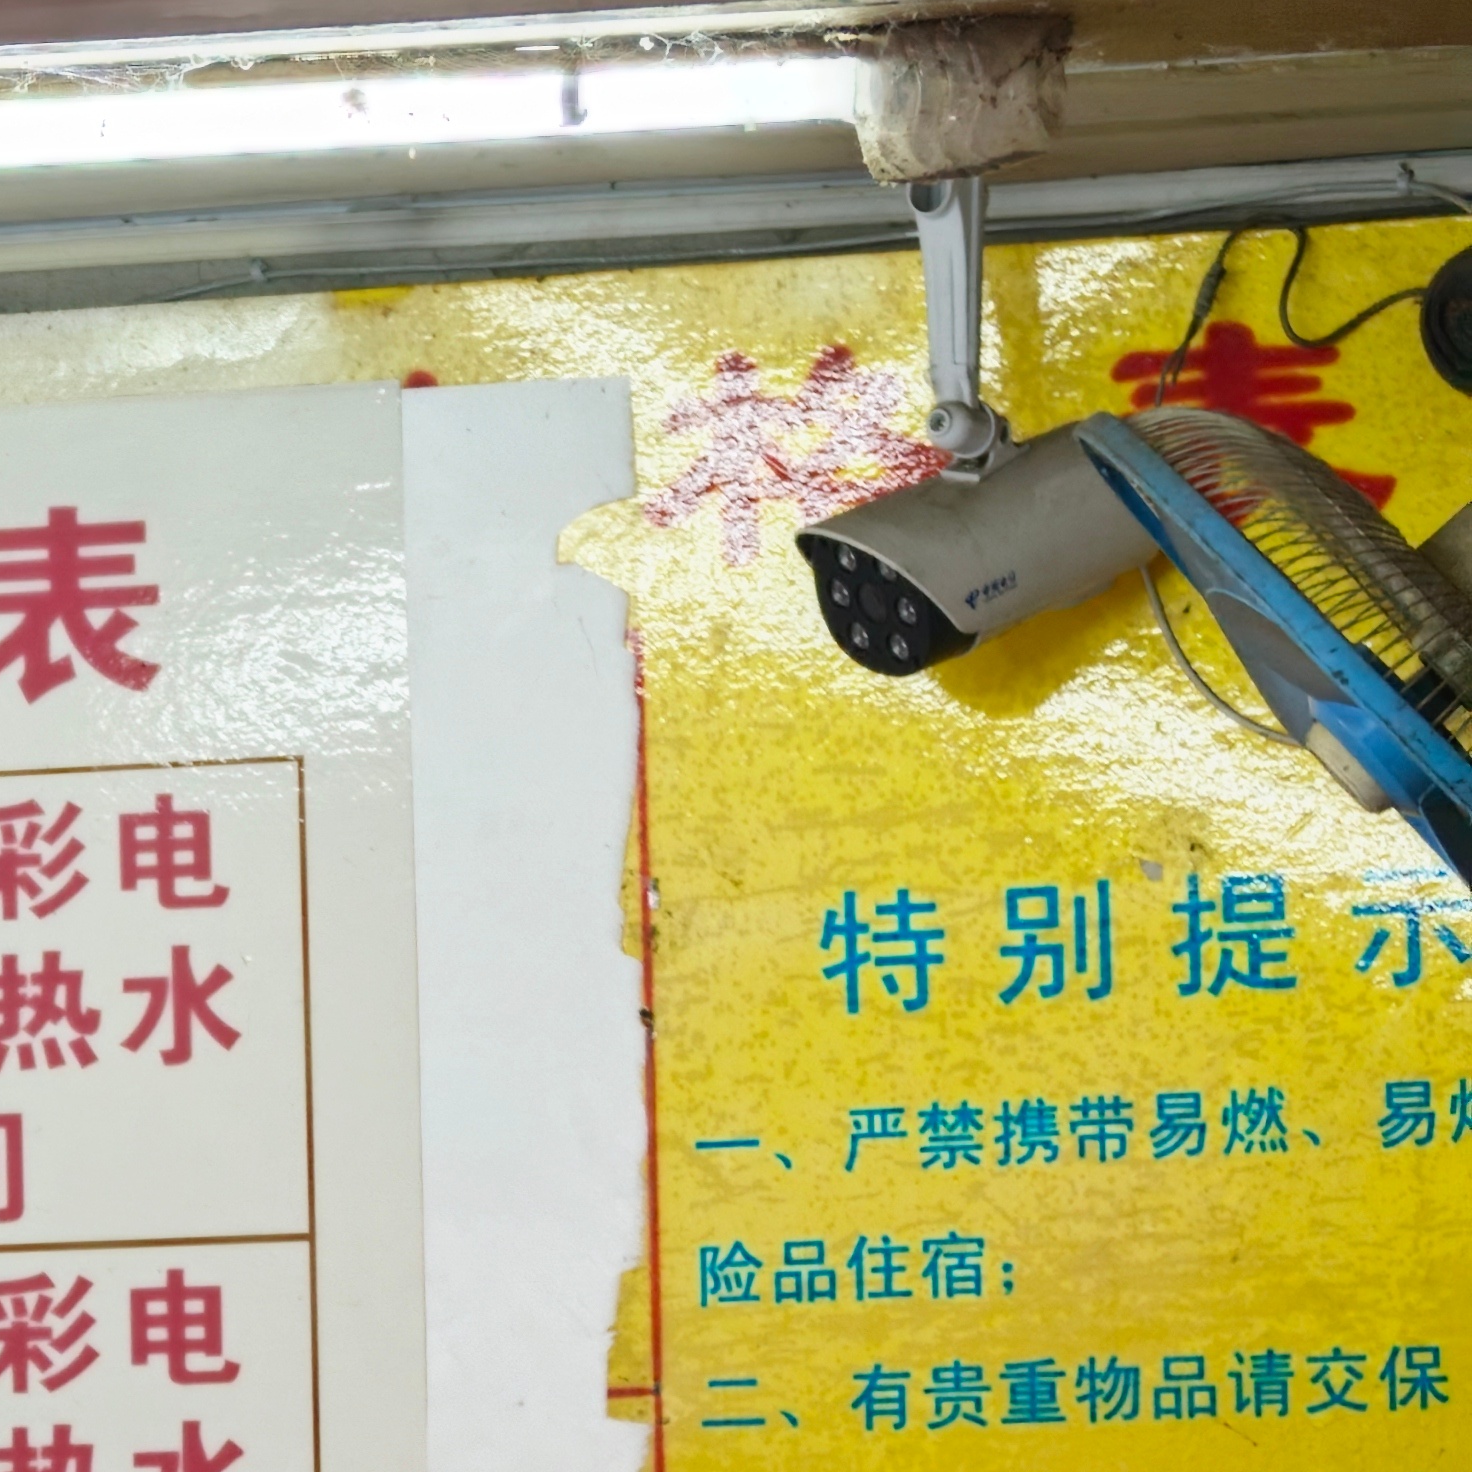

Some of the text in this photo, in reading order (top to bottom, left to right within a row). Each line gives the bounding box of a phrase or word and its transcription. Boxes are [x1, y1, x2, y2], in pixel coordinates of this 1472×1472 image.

[820, 869, 1472, 1015] 特别提示
[701, 1344, 1451, 1432] 二、有贵重物品请交保
